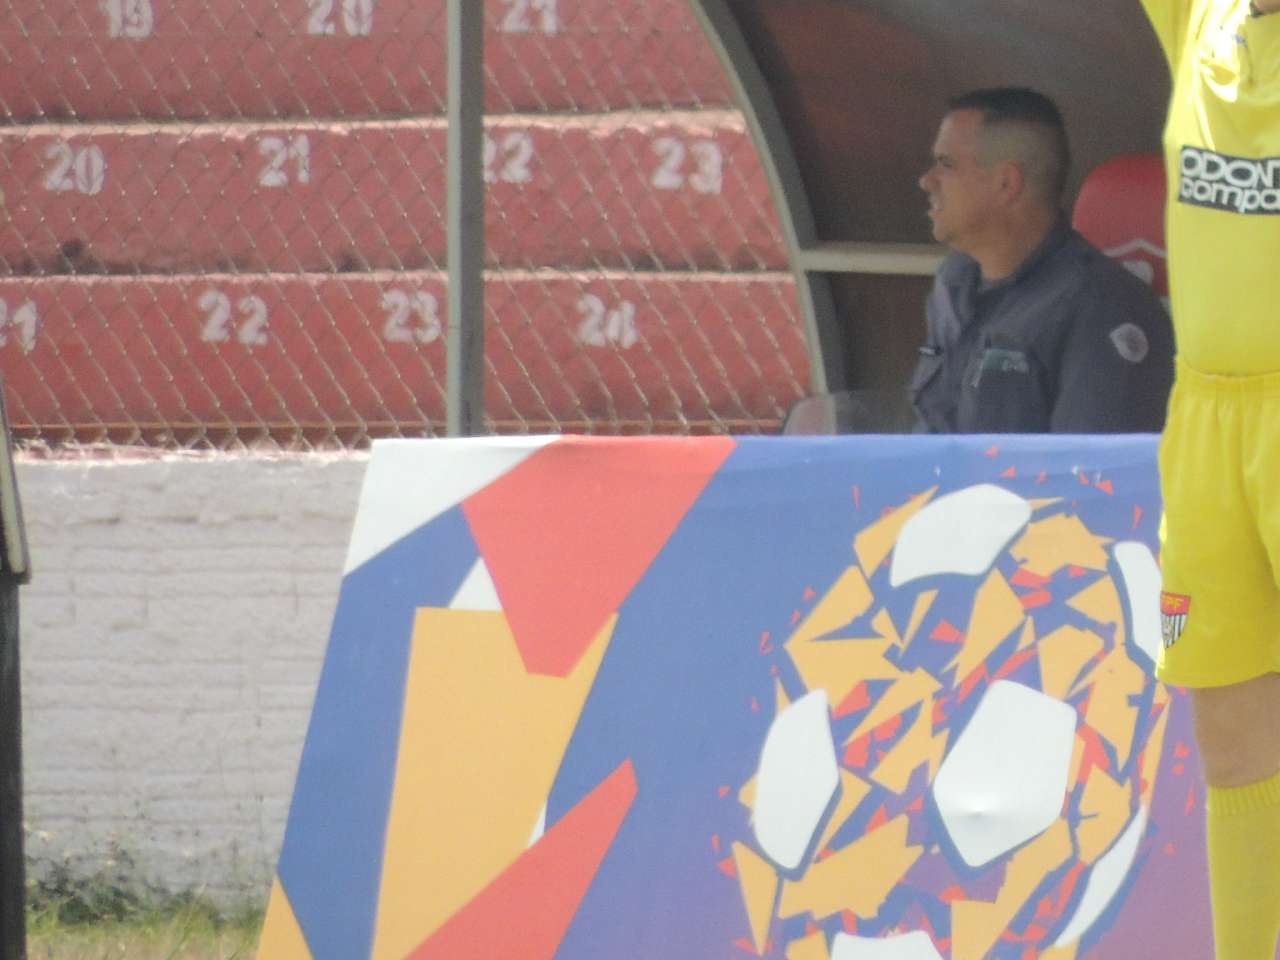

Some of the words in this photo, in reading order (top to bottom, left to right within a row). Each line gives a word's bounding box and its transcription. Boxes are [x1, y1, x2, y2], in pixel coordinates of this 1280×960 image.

[43, 138, 106, 195] 20
[258, 134, 311, 188] 21
[652, 138, 722, 192] 23
[198, 291, 269, 346] 22
[381, 290, 442, 344] 23
[576, 294, 637, 349] 24
